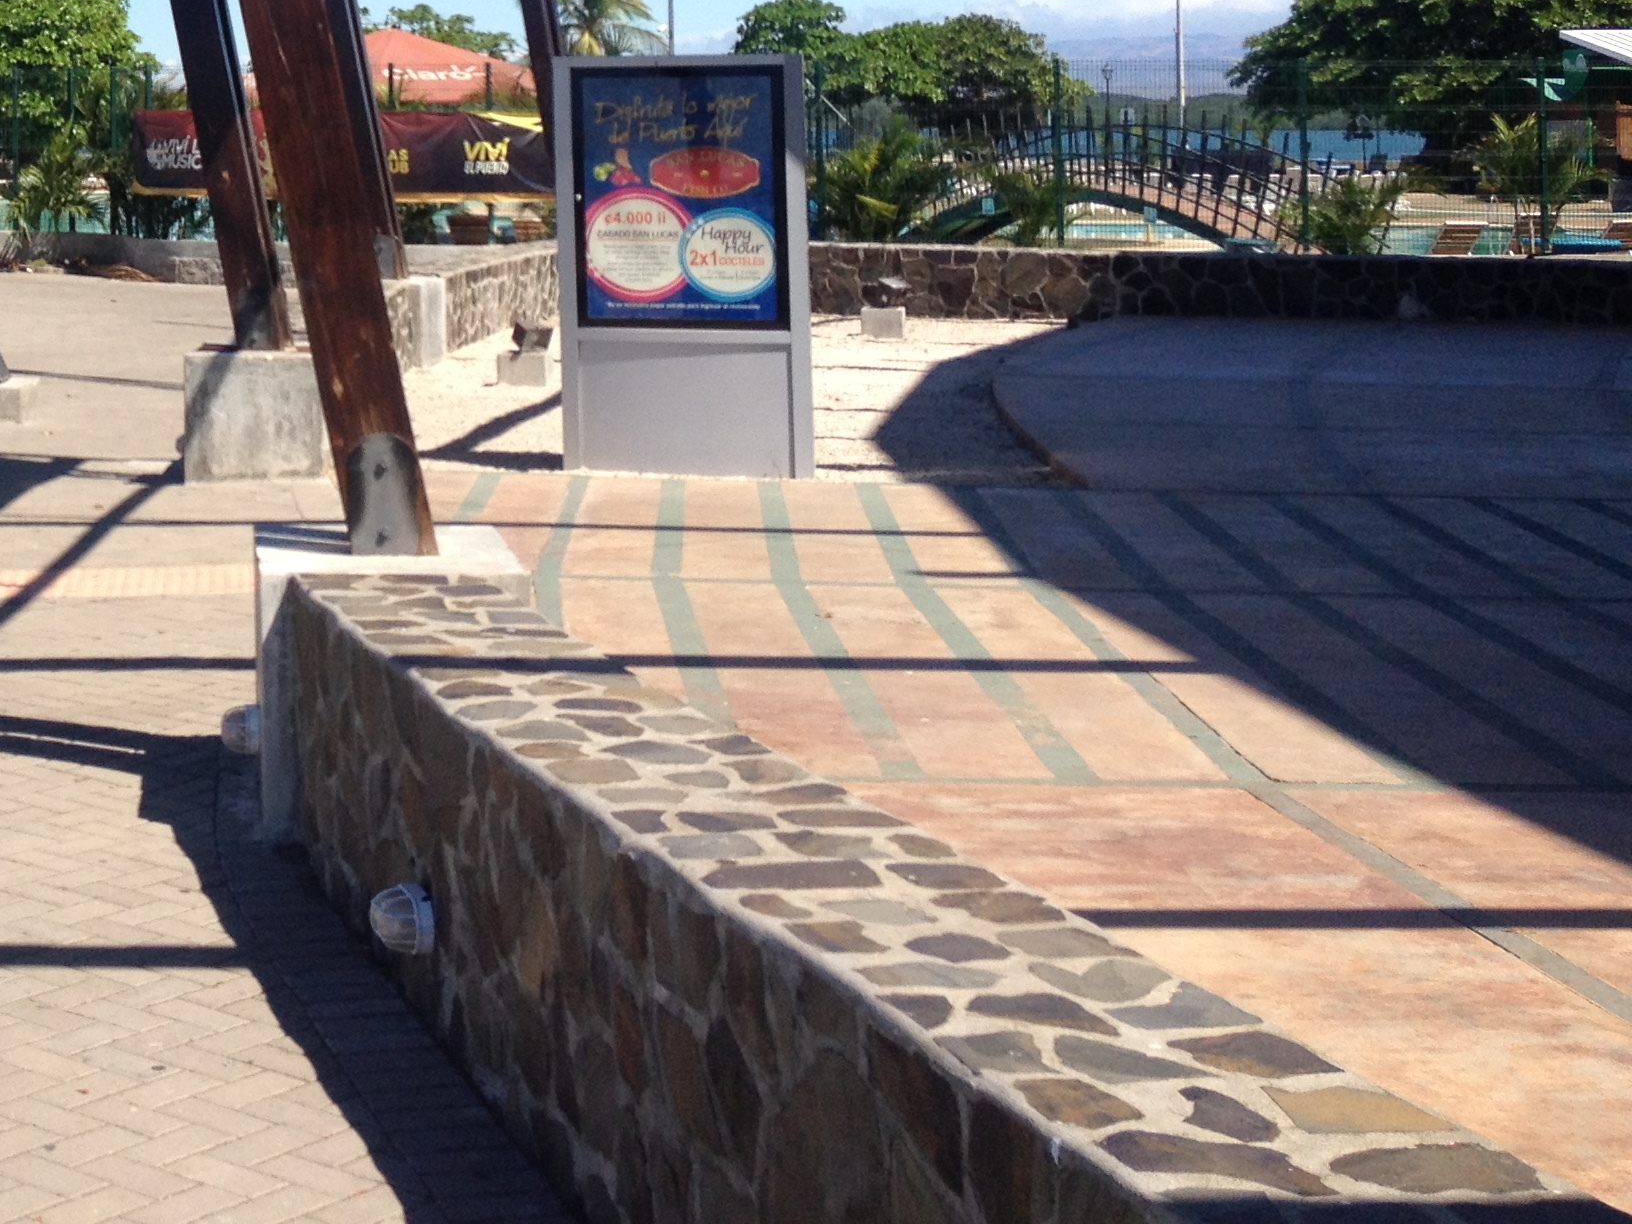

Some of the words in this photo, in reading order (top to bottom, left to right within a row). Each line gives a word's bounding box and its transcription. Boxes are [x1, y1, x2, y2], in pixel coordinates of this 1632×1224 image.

[651, 230, 679, 238] LUCAS
[701, 226, 751, 245] Happy
[724, 241, 764, 254] Hour
[690, 249, 717, 266] 2x1
[719, 256, 765, 266] COCTELES
